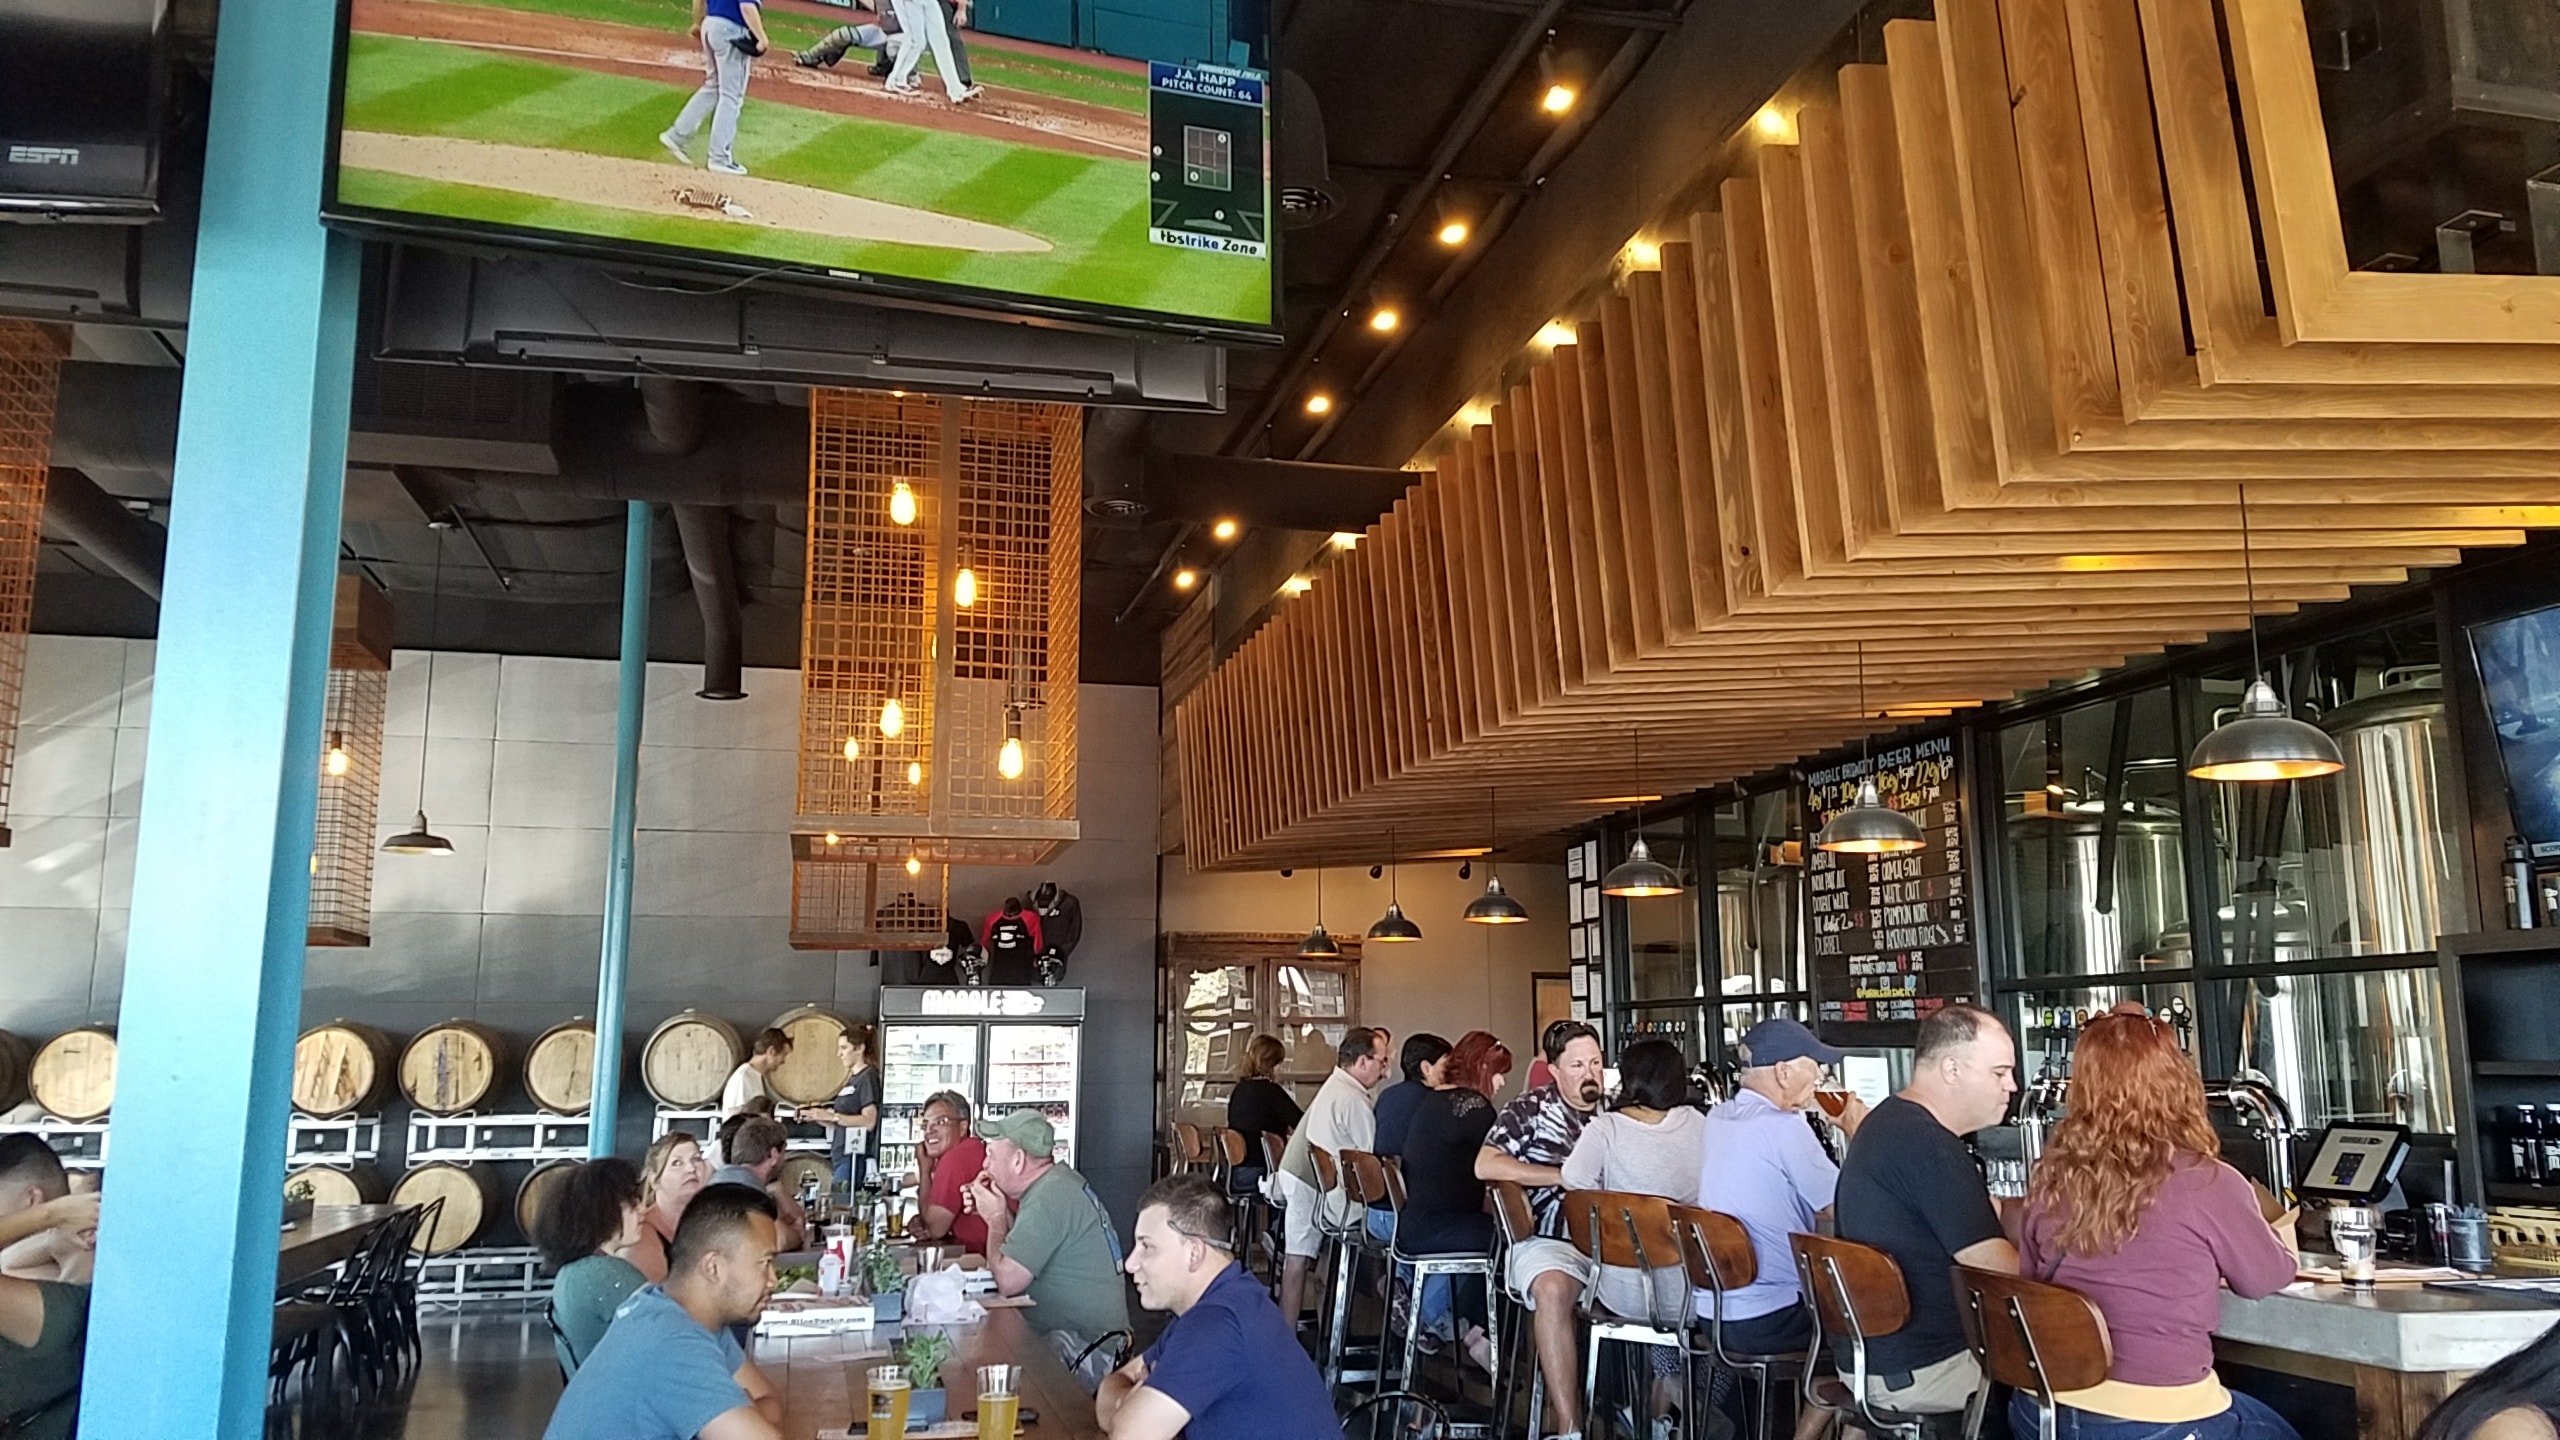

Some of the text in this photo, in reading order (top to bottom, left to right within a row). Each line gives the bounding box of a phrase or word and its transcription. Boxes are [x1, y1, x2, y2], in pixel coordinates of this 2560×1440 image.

[1175, 68, 1236, 87] J.A. HAPP
[1162, 77, 1252, 101] PITCH COUNT: 64
[9, 145, 80, 165] ESPN
[1222, 238, 1258, 255] Zone
[1808, 766, 1840, 788] MARBLE
[1878, 746, 1912, 770] BEER
[1915, 736, 1950, 759] MENU
[1903, 856, 1922, 877] STOUT
[1905, 881, 1920, 902] OUT
[1883, 904, 1912, 928] PUMPKIN
[1815, 934, 1843, 956] DUBBEL
